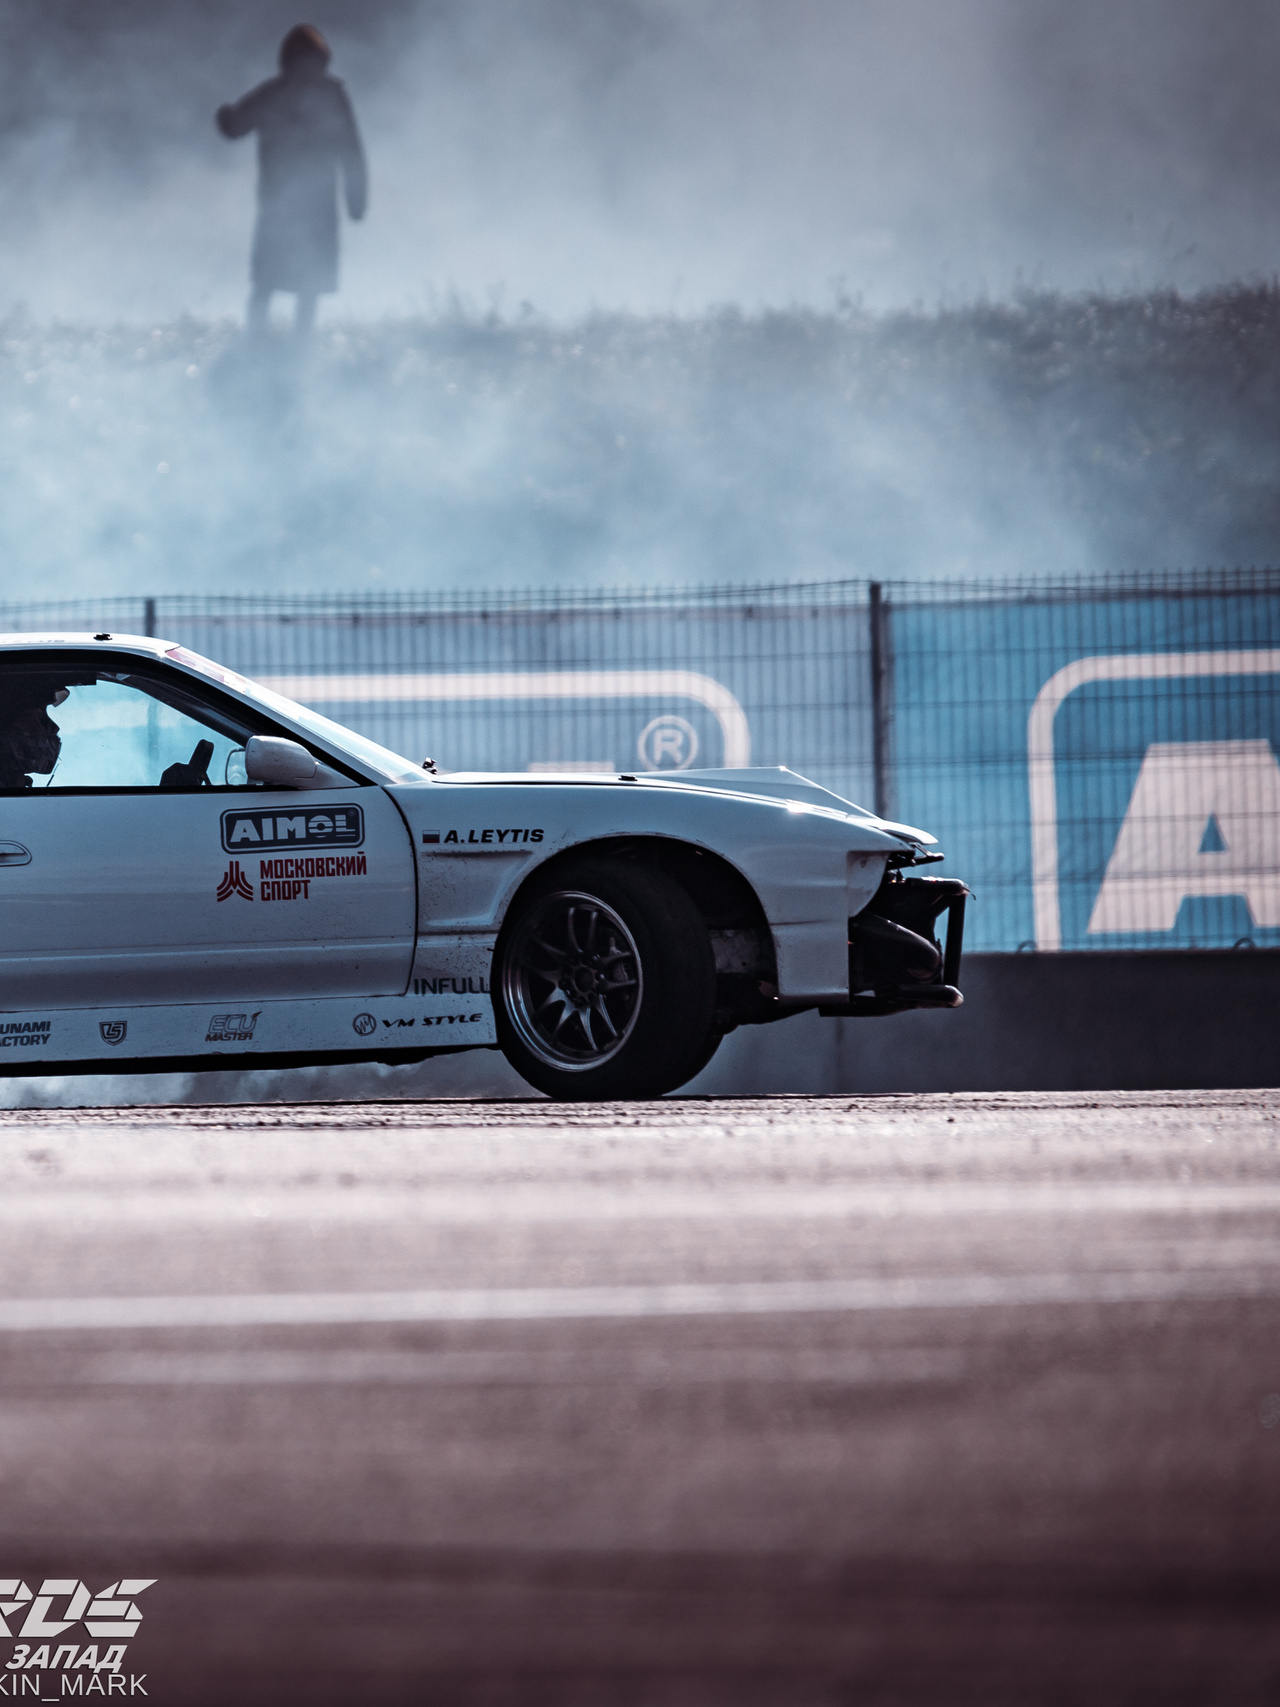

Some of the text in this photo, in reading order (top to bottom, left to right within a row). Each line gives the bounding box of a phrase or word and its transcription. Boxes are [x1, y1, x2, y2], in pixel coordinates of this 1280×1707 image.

[229, 814, 357, 843] AIMOL
[443, 828, 545, 844] A.LEYTIS
[260, 851, 368, 880] МОСКОВСКИЙ
[260, 879, 311, 902] СПОРТ
[208, 1011, 263, 1034] ECU
[381, 1018, 416, 1028] VM
[421, 1013, 483, 1026] STYLE
[205, 1032, 254, 1042] MASTER
